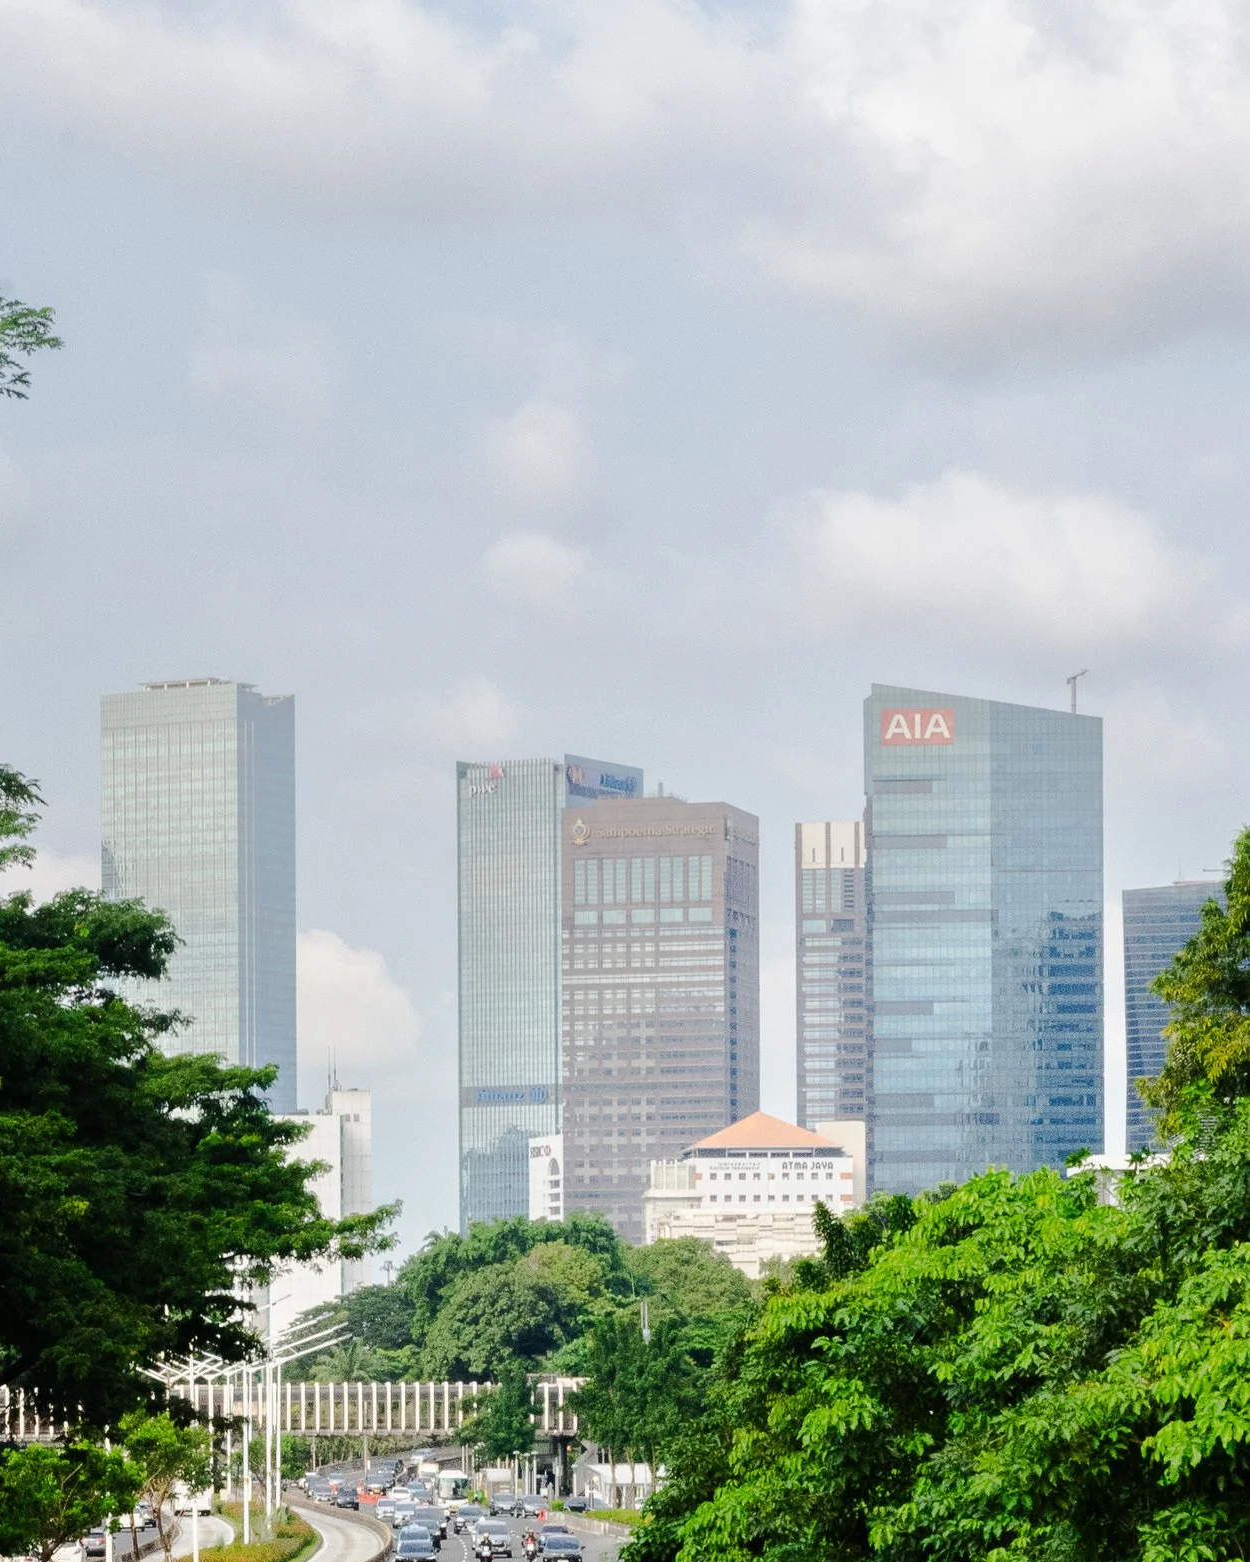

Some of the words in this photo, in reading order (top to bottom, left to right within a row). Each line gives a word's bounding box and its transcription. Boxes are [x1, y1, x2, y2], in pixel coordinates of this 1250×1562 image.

[885, 713, 951, 739] AIA
[469, 784, 497, 797] pwc
[666, 823, 716, 836] Strategic
[782, 1162, 808, 1170] ATMA
[810, 1162, 834, 1170] JAYA
